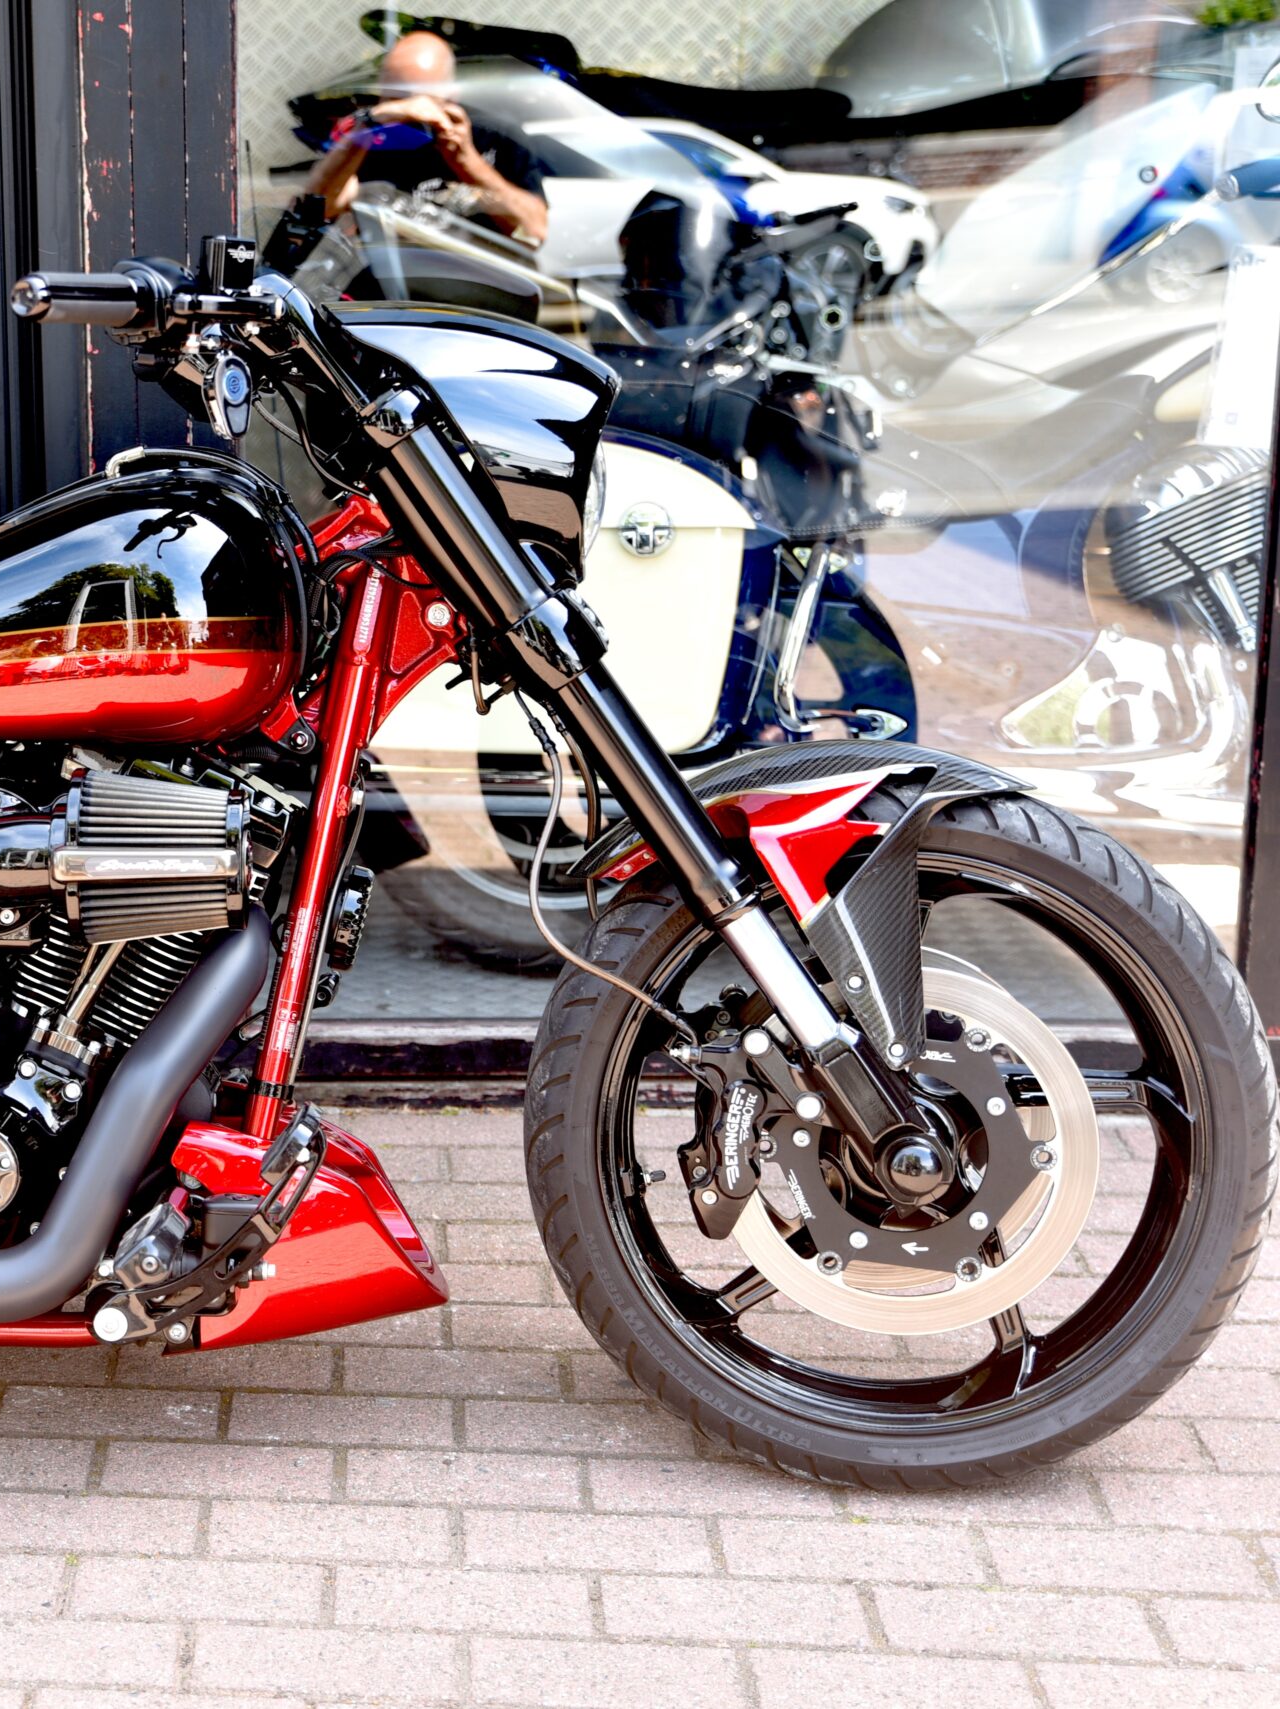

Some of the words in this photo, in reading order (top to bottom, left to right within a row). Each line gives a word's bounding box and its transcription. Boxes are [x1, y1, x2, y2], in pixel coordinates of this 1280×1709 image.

[725, 1087, 746, 1190] BERINGER
[739, 1092, 758, 1145] AEROTEC
[787, 1168, 816, 1220] BERINGER
